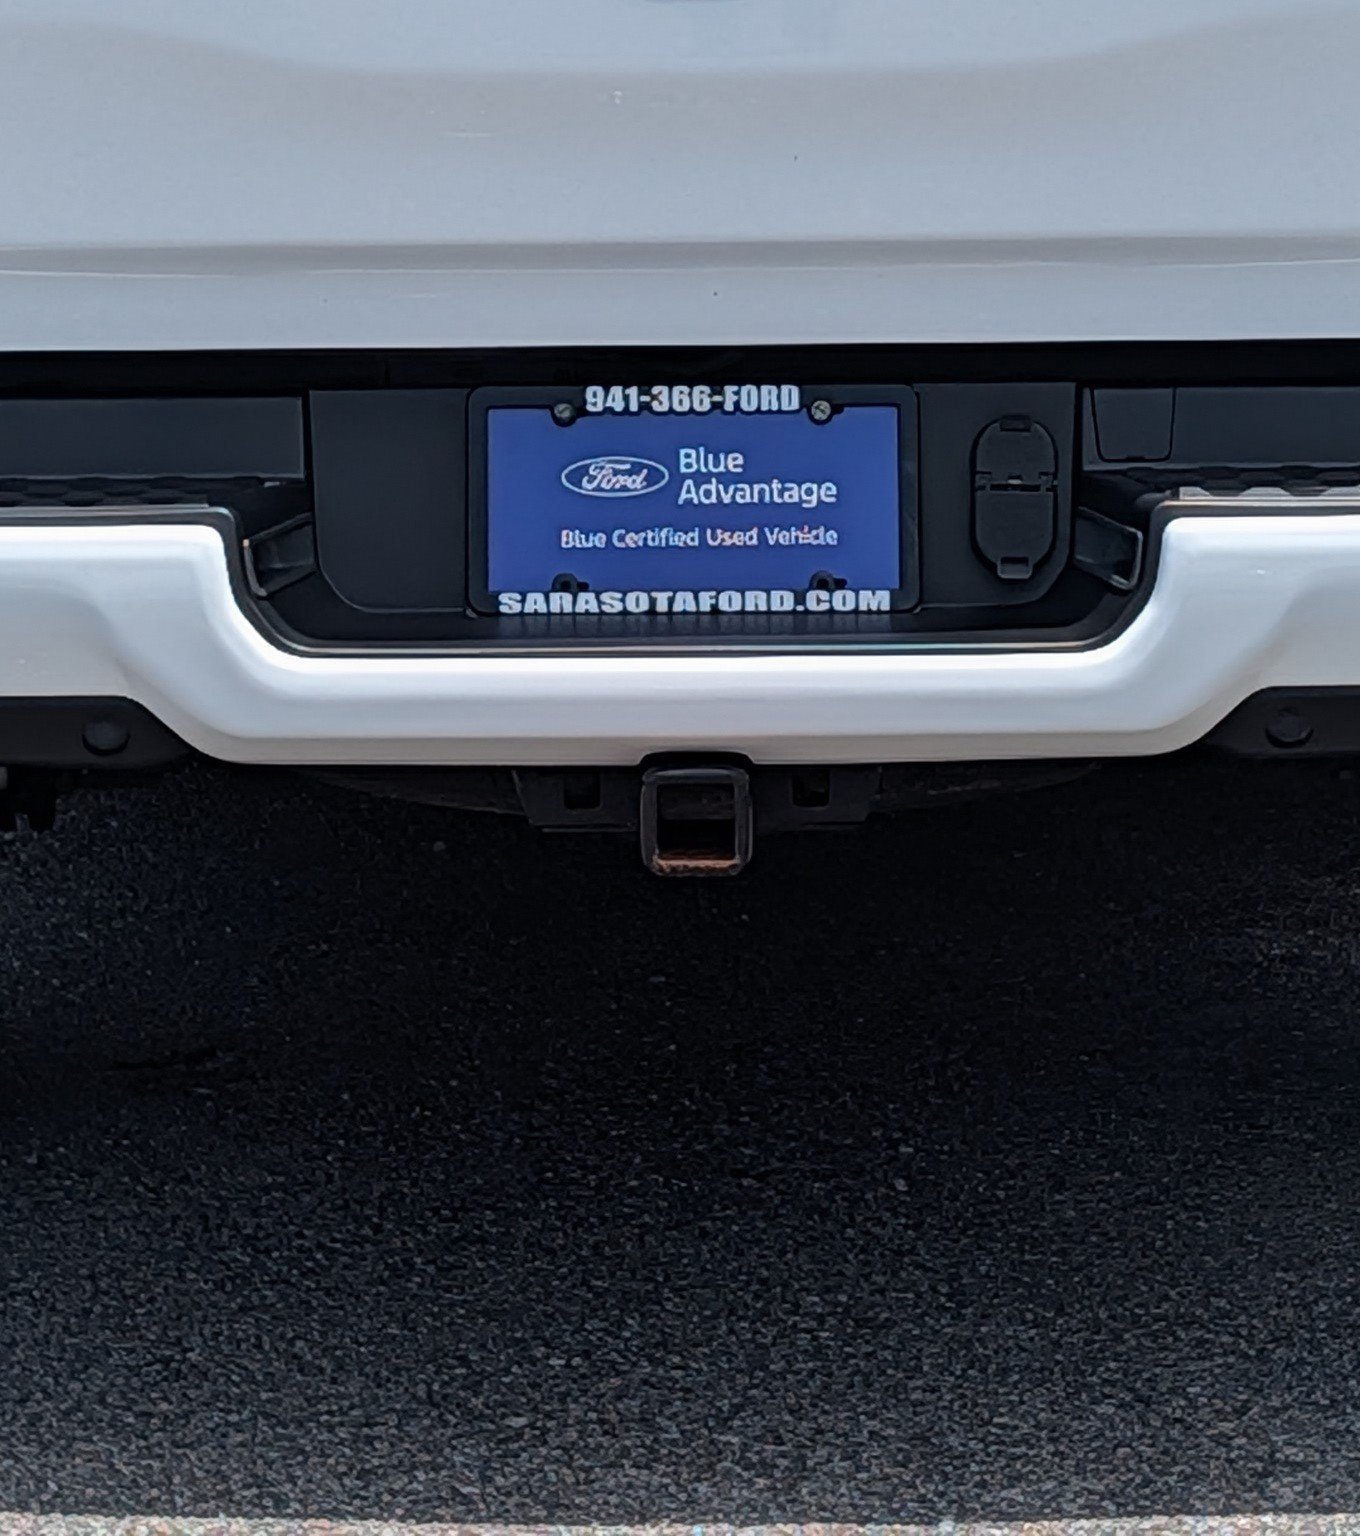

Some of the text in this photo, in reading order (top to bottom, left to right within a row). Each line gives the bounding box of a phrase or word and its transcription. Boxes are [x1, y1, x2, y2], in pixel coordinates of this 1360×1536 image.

[585, 385, 800, 412] 941-366-FORD
[679, 447, 744, 474] Blue
[581, 462, 648, 490] Ford
[677, 478, 838, 508] Advantage
[561, 526, 838, 548] Blue Certified Used Vehicle
[498, 590, 891, 614] SARASOTAFORD.COM
